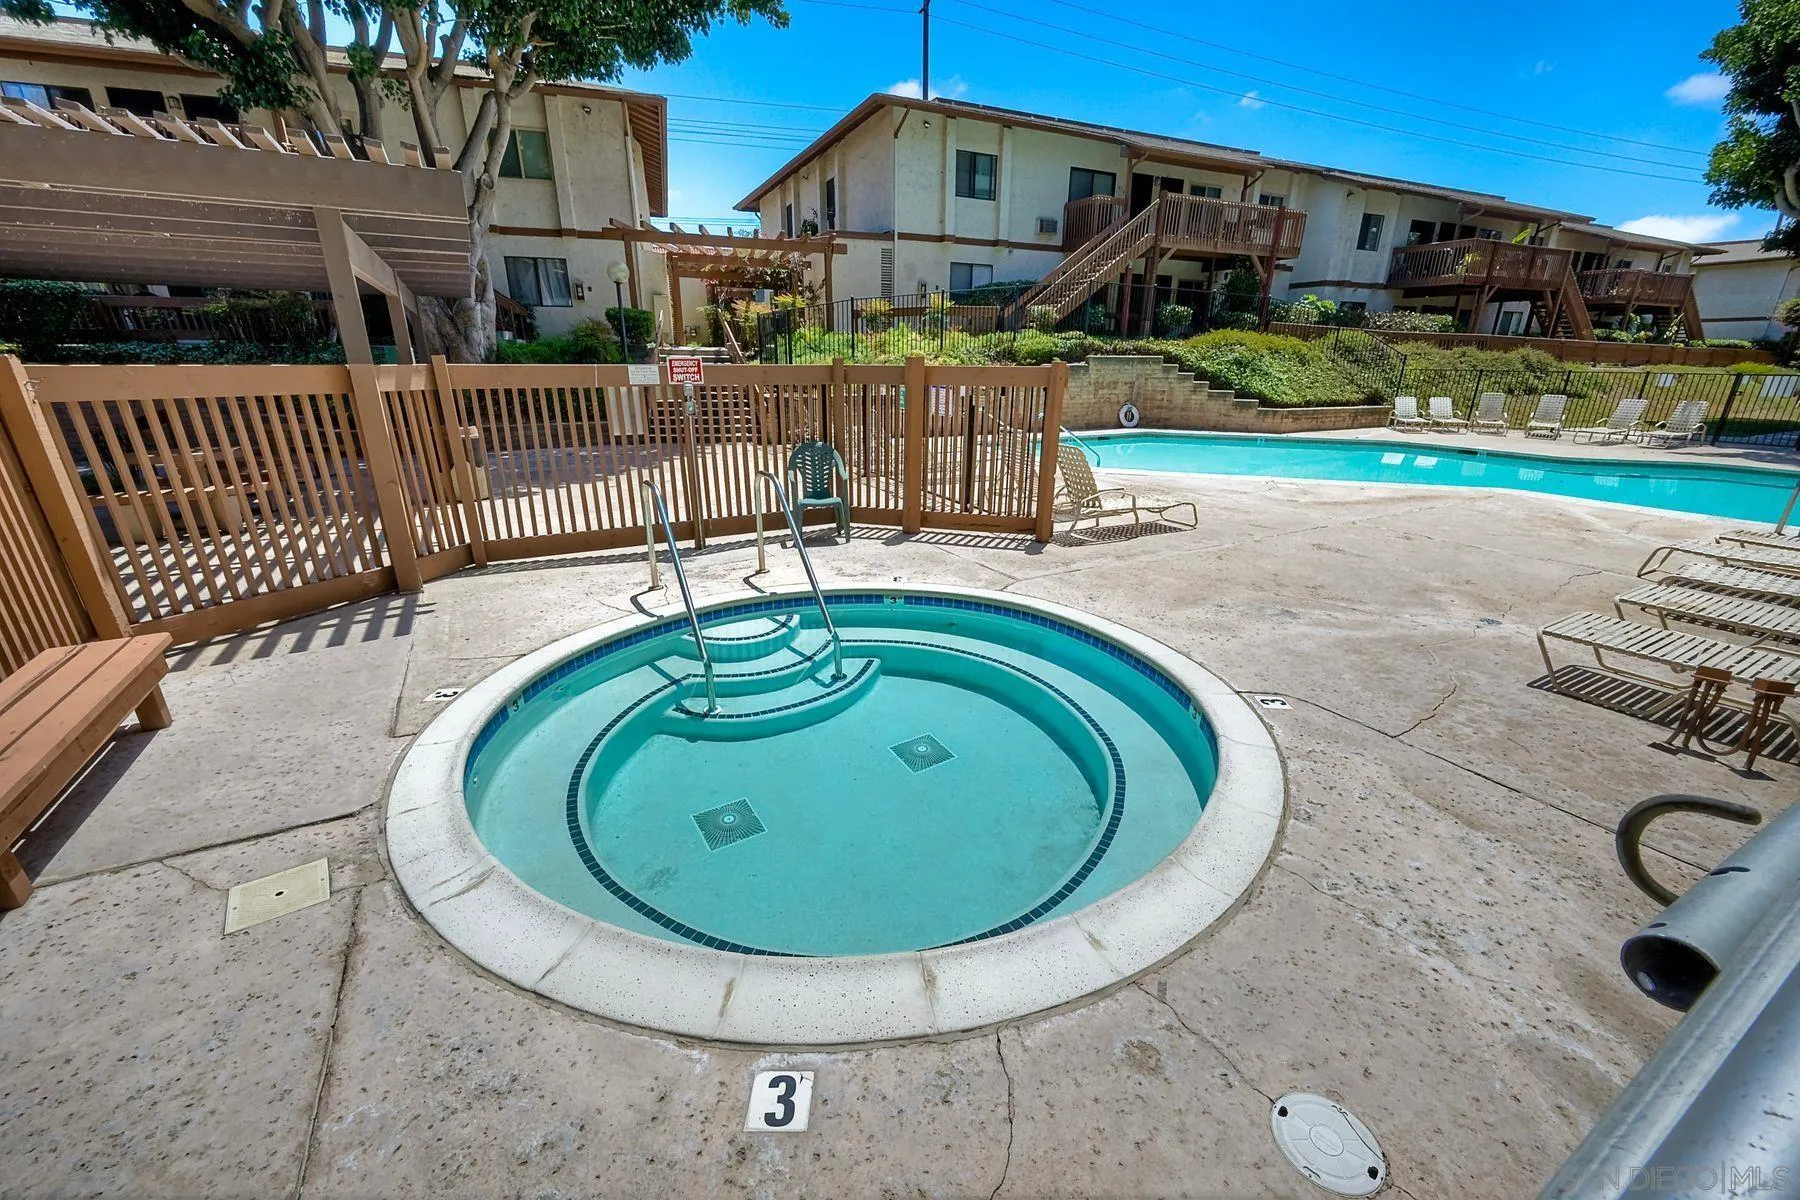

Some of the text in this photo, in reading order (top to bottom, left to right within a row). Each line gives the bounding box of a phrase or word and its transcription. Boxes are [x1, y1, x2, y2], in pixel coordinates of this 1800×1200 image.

[672, 373, 700, 382] SWITCH
[1259, 698, 1287, 706] 3
[763, 1074, 797, 1128] 3
